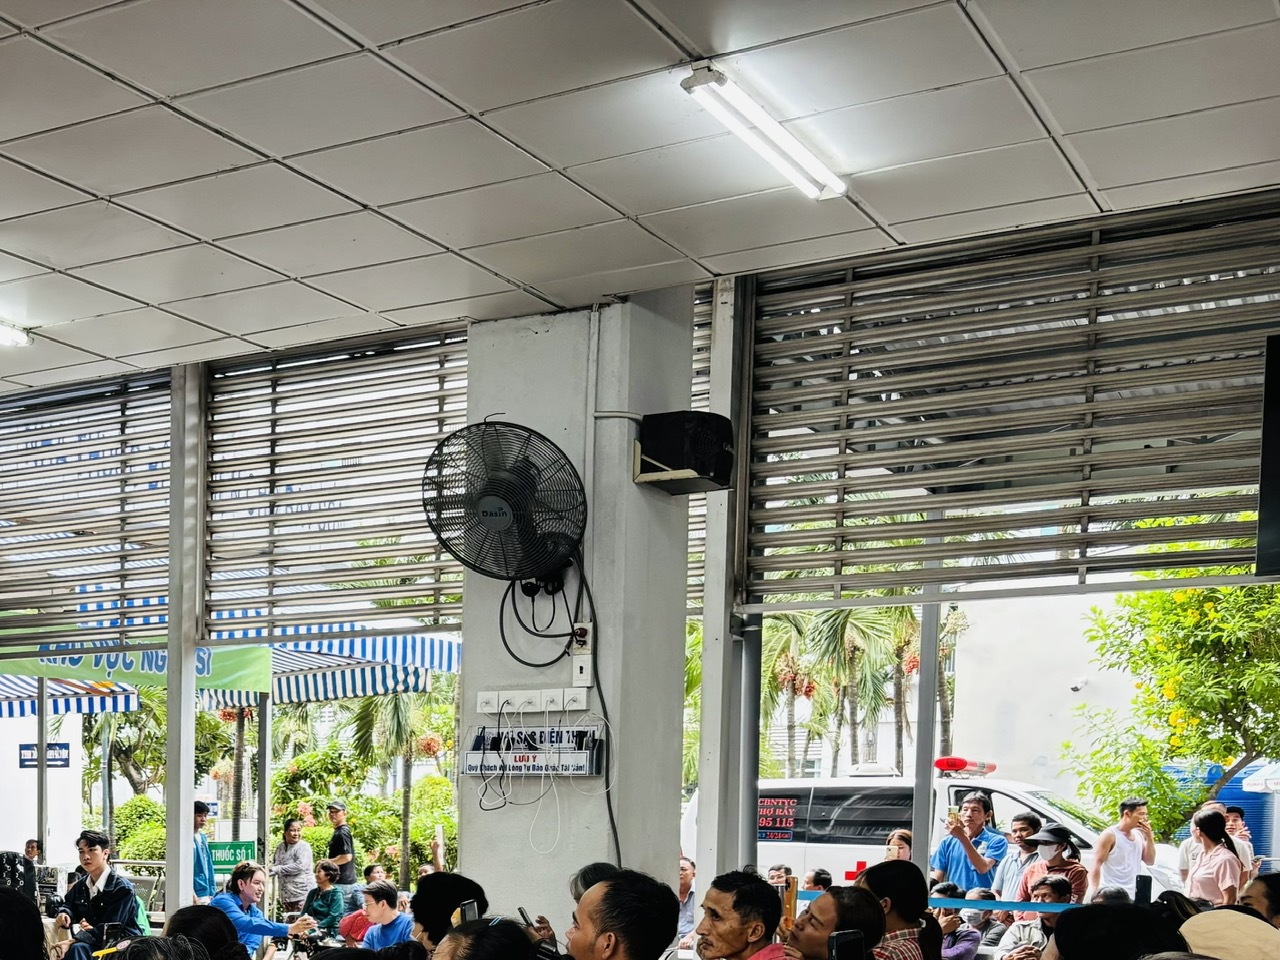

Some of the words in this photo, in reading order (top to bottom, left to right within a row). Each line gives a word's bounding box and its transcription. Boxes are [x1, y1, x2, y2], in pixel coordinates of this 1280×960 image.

[775, 817, 794, 828] 115
[211, 845, 235, 861] THUỐC
[236, 845, 246, 861] SỐ
